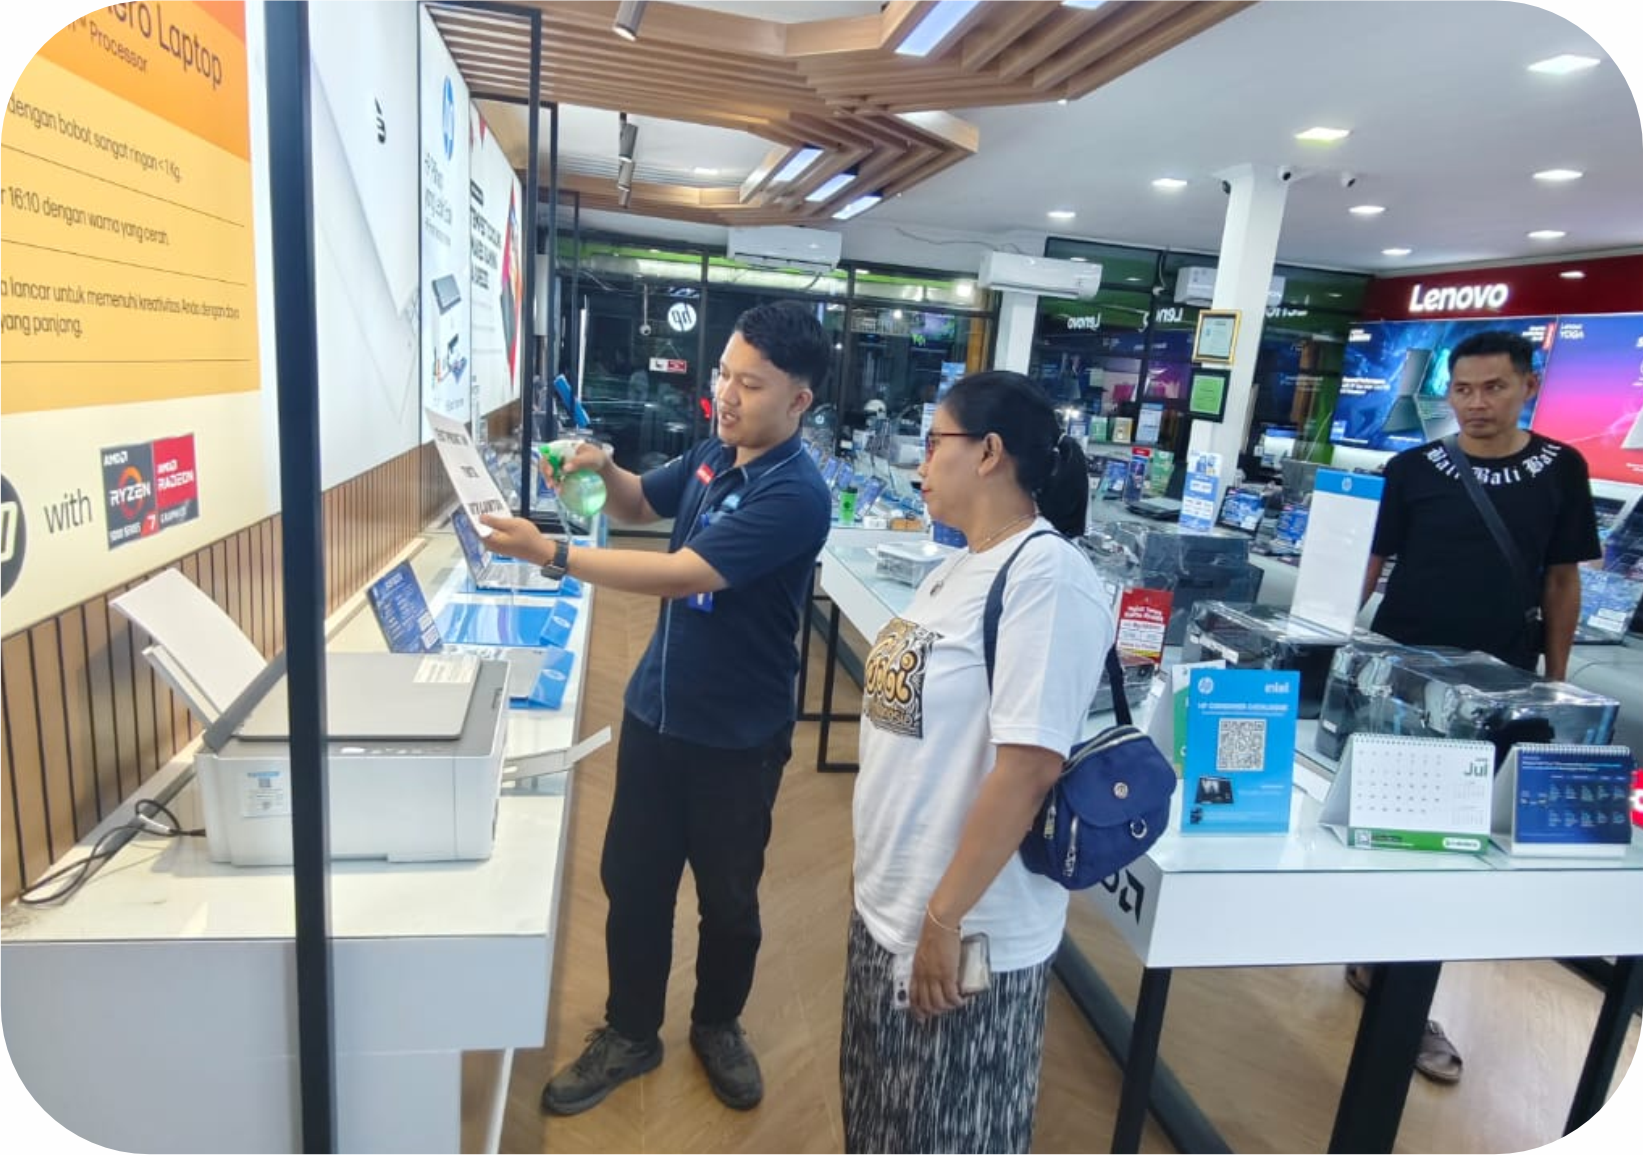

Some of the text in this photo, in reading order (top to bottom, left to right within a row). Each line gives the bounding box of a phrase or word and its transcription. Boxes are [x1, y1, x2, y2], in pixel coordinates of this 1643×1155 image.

[89, 20, 148, 73] Processor
[156, 3, 223, 91] Laptop
[8, 93, 57, 130] dengan
[58, 113, 93, 146] bobot
[94, 131, 129, 160] sangat
[129, 147, 158, 171] ringan
[8, 186, 40, 214] 16:10
[42, 197, 87, 226] dengan
[88, 212, 120, 234] warna
[121, 219, 143, 243] yang
[9, 275, 51, 301] lancar
[53, 284, 84, 304] untuk
[87, 290, 138, 310] memenuhi
[1408, 282, 1509, 313] Lenovo
[33, 313, 83, 338] panjang.
[104, 451, 127, 467] AMD
[1471, 465, 1531, 486] Bali
[1522, 443, 1563, 478] Bali
[109, 481, 151, 507] RYZEN
[157, 470, 194, 491] RADEON
[43, 488, 93, 534] with
[147, 514, 156, 531] 7
[1463, 762, 1488, 777] Jul
